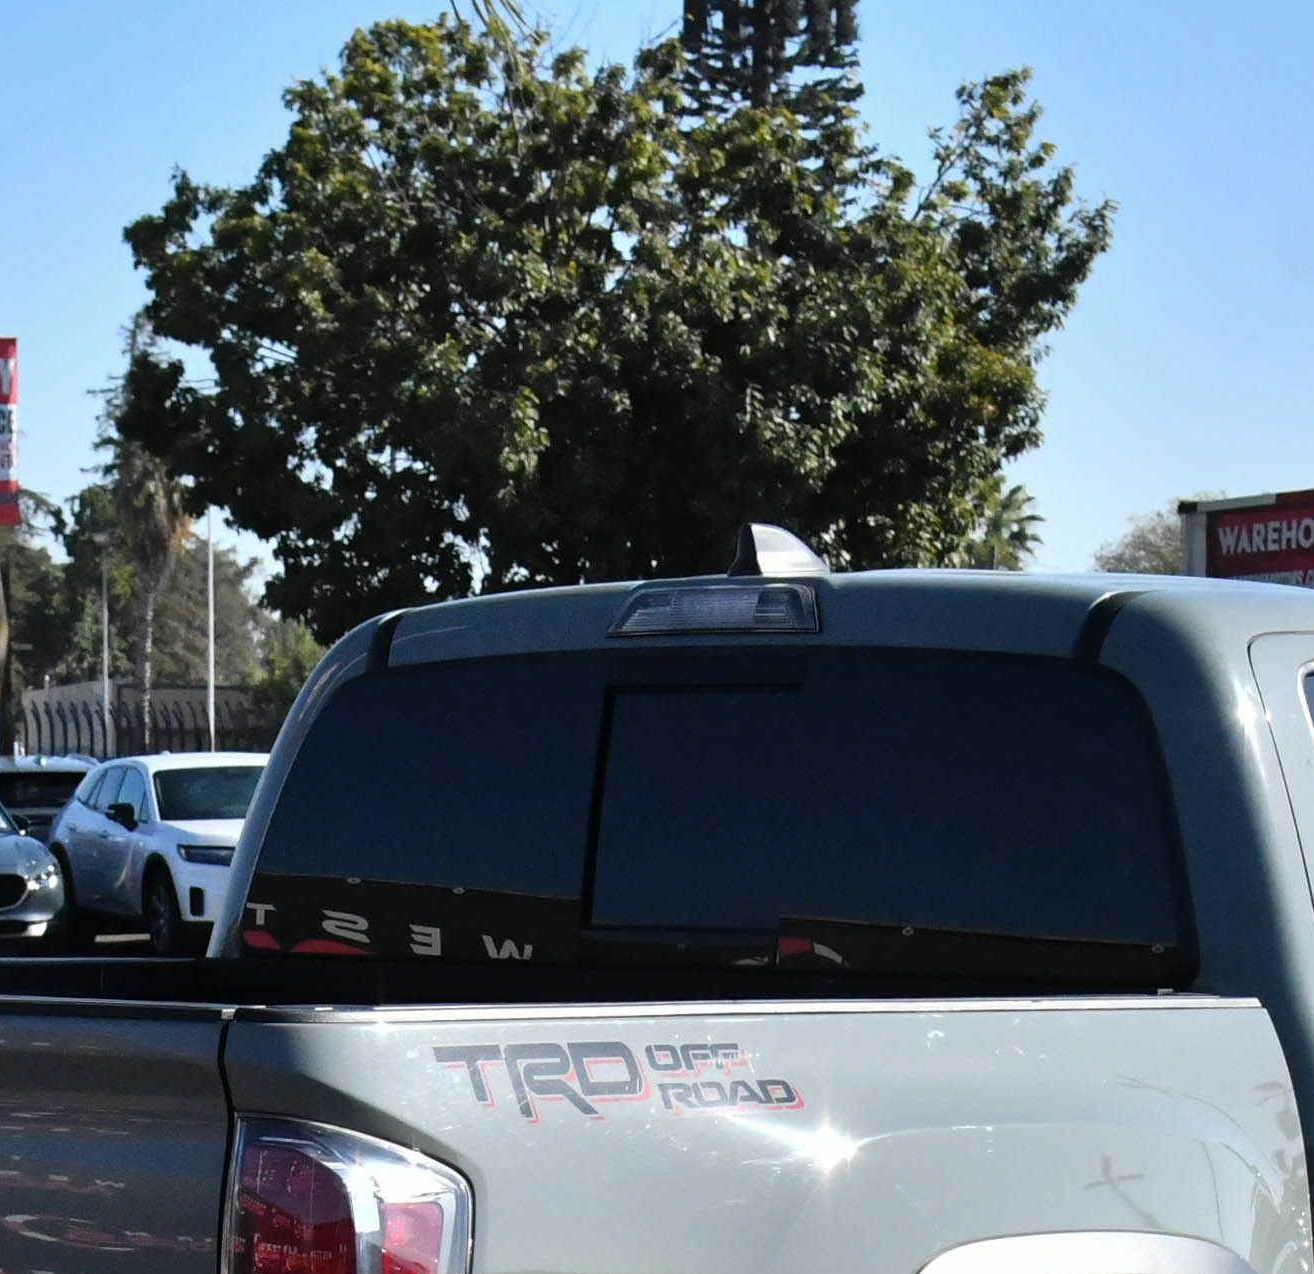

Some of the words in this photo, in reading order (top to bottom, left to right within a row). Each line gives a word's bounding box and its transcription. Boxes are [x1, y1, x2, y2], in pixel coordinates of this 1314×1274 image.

[644, 1042, 749, 1077] OFF
[433, 1041, 652, 1124] TRD
[653, 1078, 805, 1117] ROAD
